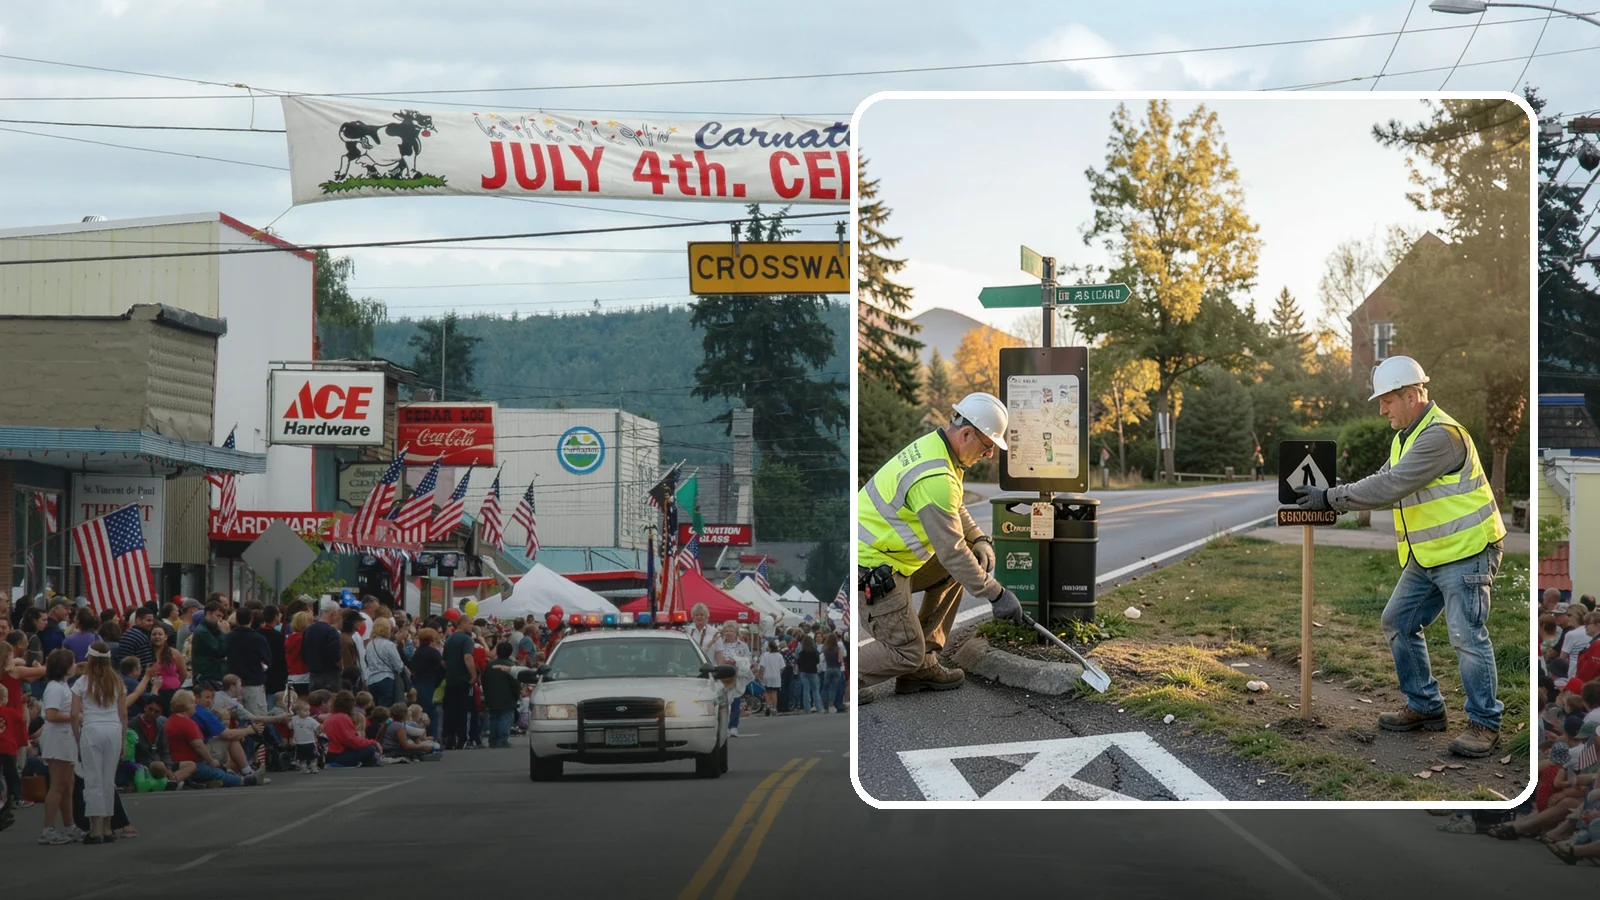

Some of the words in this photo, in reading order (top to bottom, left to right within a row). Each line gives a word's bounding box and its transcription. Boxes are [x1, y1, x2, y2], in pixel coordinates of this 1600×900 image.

[694, 121, 850, 150] Carnat
[481, 141, 605, 193] JULY
[632, 150, 746, 198] 4th.
[697, 254, 850, 280] CROSSWA
[283, 380, 373, 420] ACE
[405, 408, 452, 422] CEDAR
[461, 408, 485, 422] LOG
[283, 421, 371, 436] Hardware
[96, 485, 124, 494] Vincent
[126, 486, 136, 494] de
[137, 486, 155, 495] Paul
[700, 535, 730, 543] GLASS
